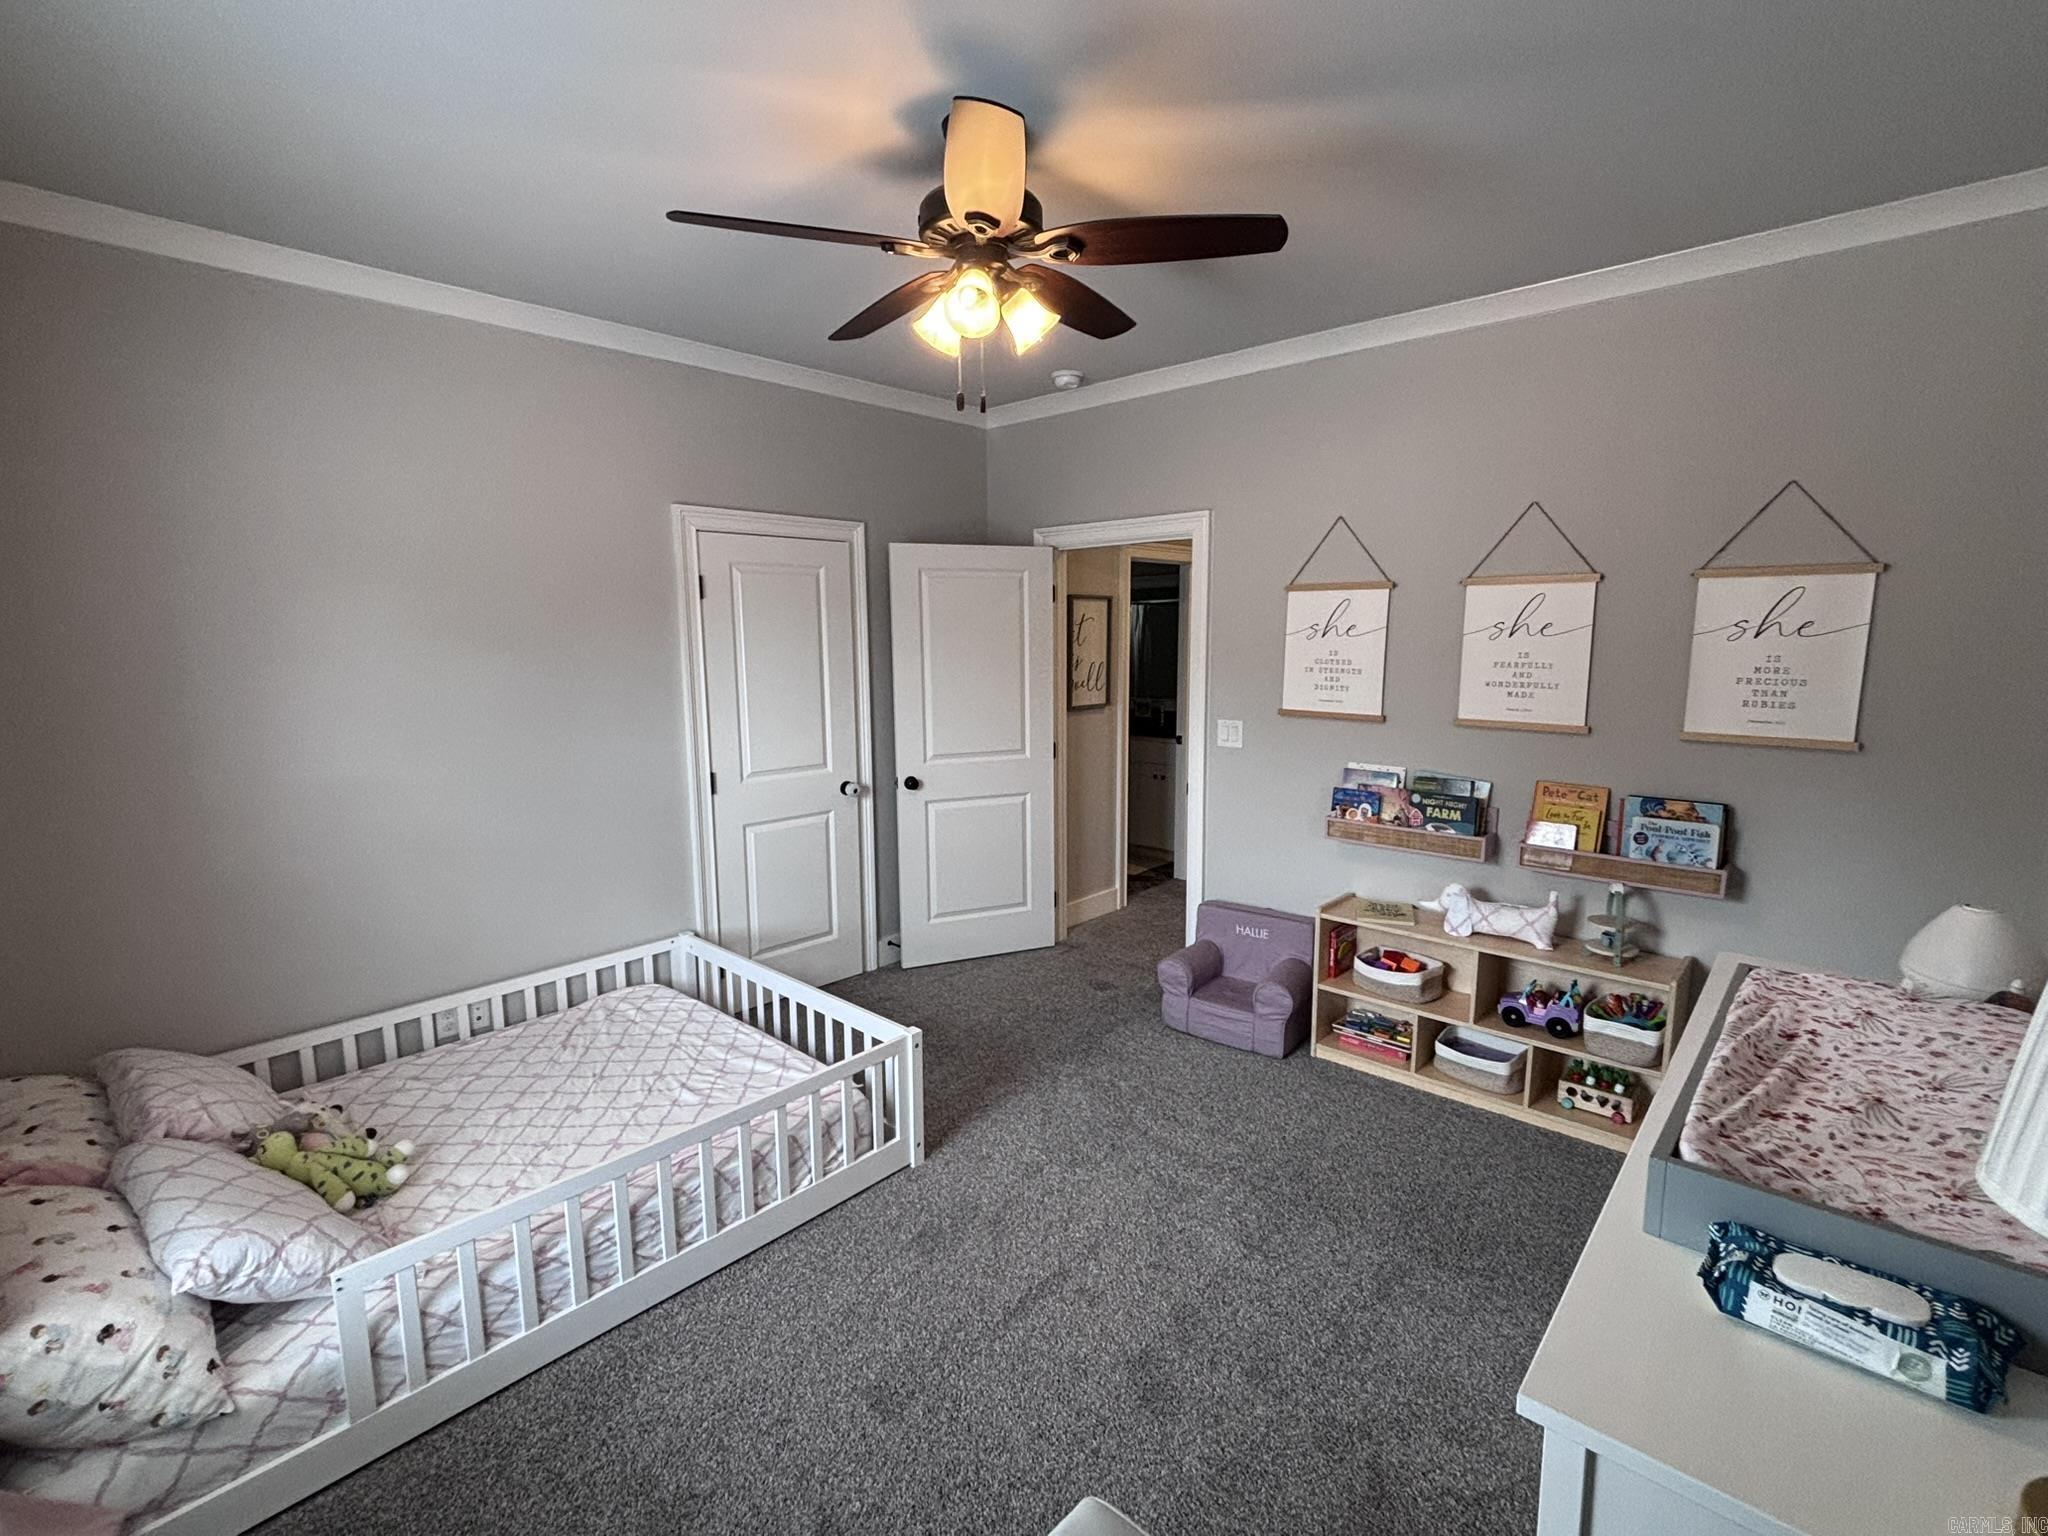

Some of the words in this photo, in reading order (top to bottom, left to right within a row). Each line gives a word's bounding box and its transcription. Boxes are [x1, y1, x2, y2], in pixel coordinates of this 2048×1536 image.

[1517, 651, 1530, 659] IS
[1766, 655, 1781, 663] IS
[1314, 658, 1353, 666] CLOTHED
[1492, 661, 1554, 670] FEARFULLY
[1318, 667, 1362, 675] STRENGTH
[1512, 671, 1533, 679] AND
[1753, 666, 1791, 675] MORE
[1484, 680, 1560, 690] WONDERFULLY
[1735, 677, 1808, 687] PRECIOUS
[1313, 683, 1350, 692] DIGNITY
[1506, 691, 1536, 699] MADE
[1751, 689, 1788, 698] THAN
[1742, 699, 1796, 710] RUBIES
[1542, 785, 1568, 799] Pete
[1577, 790, 1599, 802] Cat
[1422, 798, 1444, 806] NIGHT
[1425, 806, 1462, 822] FARM
[1690, 828, 1711, 838] Fish
[1235, 923, 1270, 940] HALLIE
